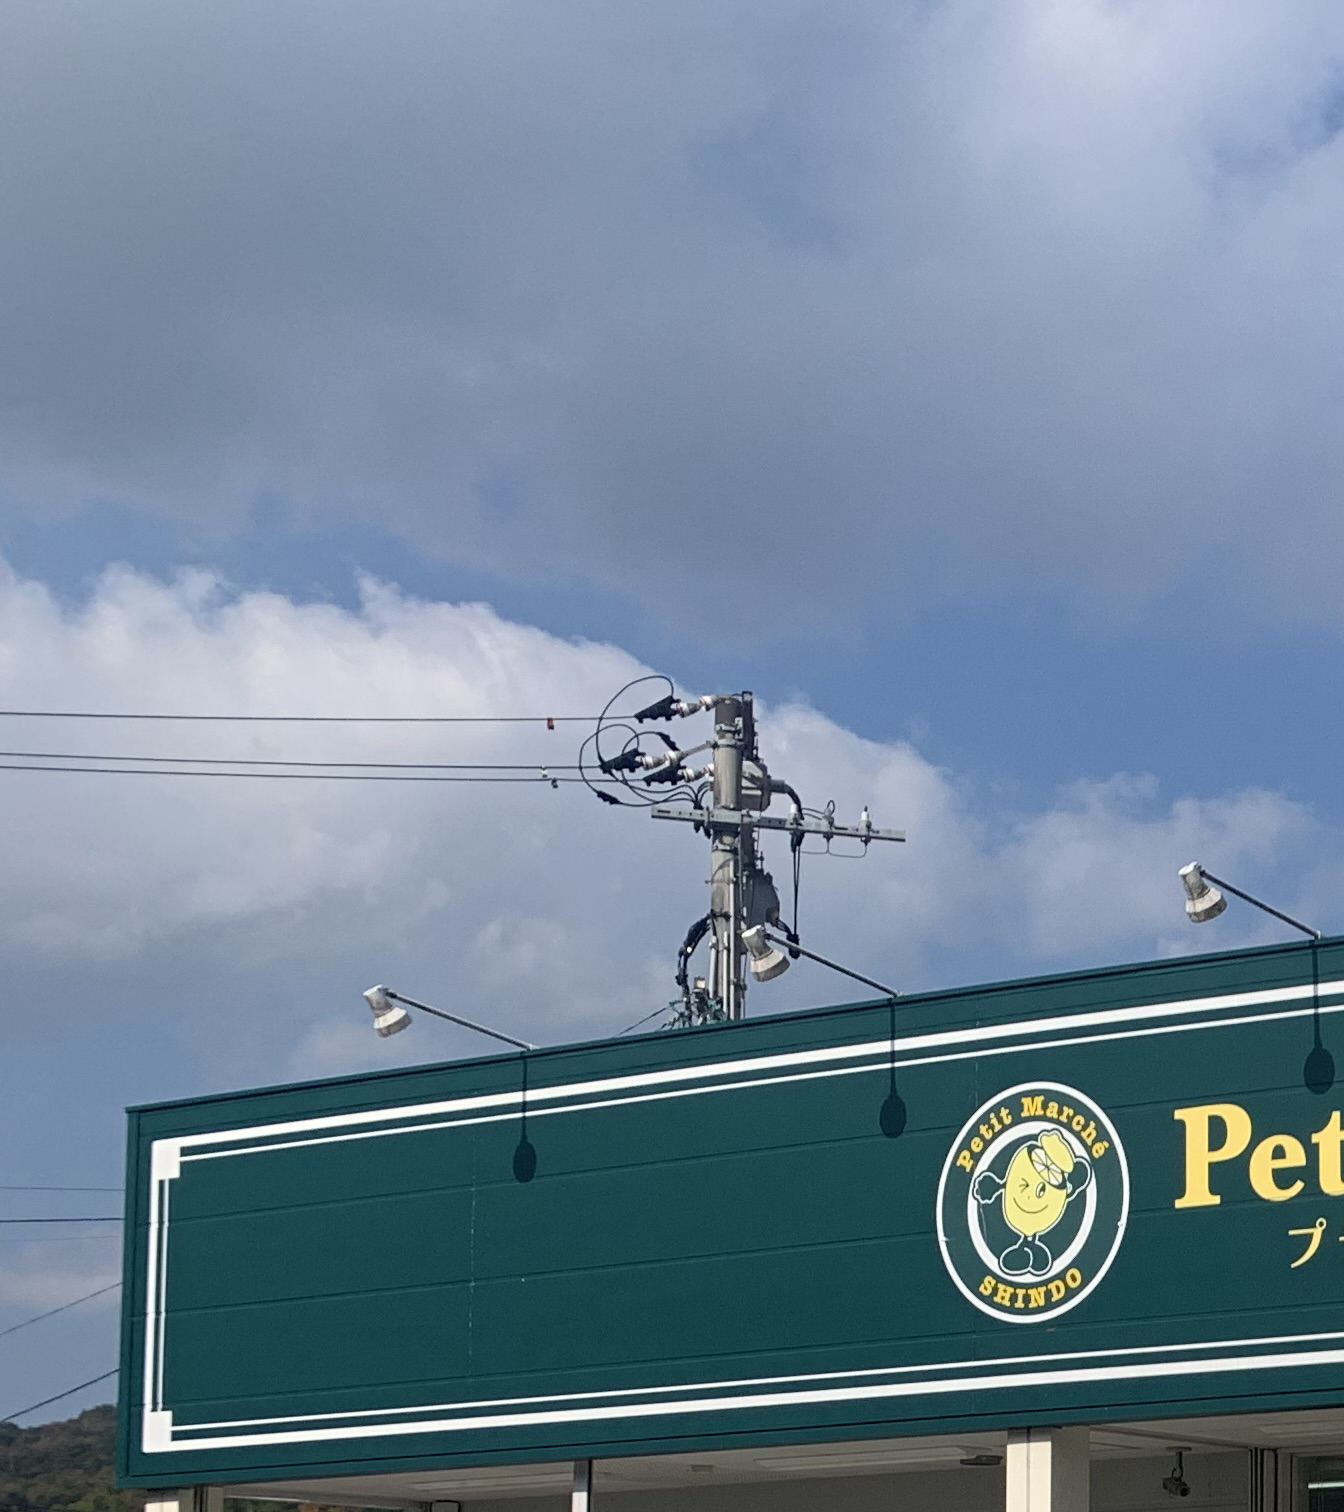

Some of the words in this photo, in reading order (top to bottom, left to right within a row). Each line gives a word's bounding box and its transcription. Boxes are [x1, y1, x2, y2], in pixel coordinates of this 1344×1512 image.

[955, 1106, 1013, 1173] Petit
[1020, 1095, 1110, 1160] Marché
[978, 1267, 1082, 1309] SHINDO
